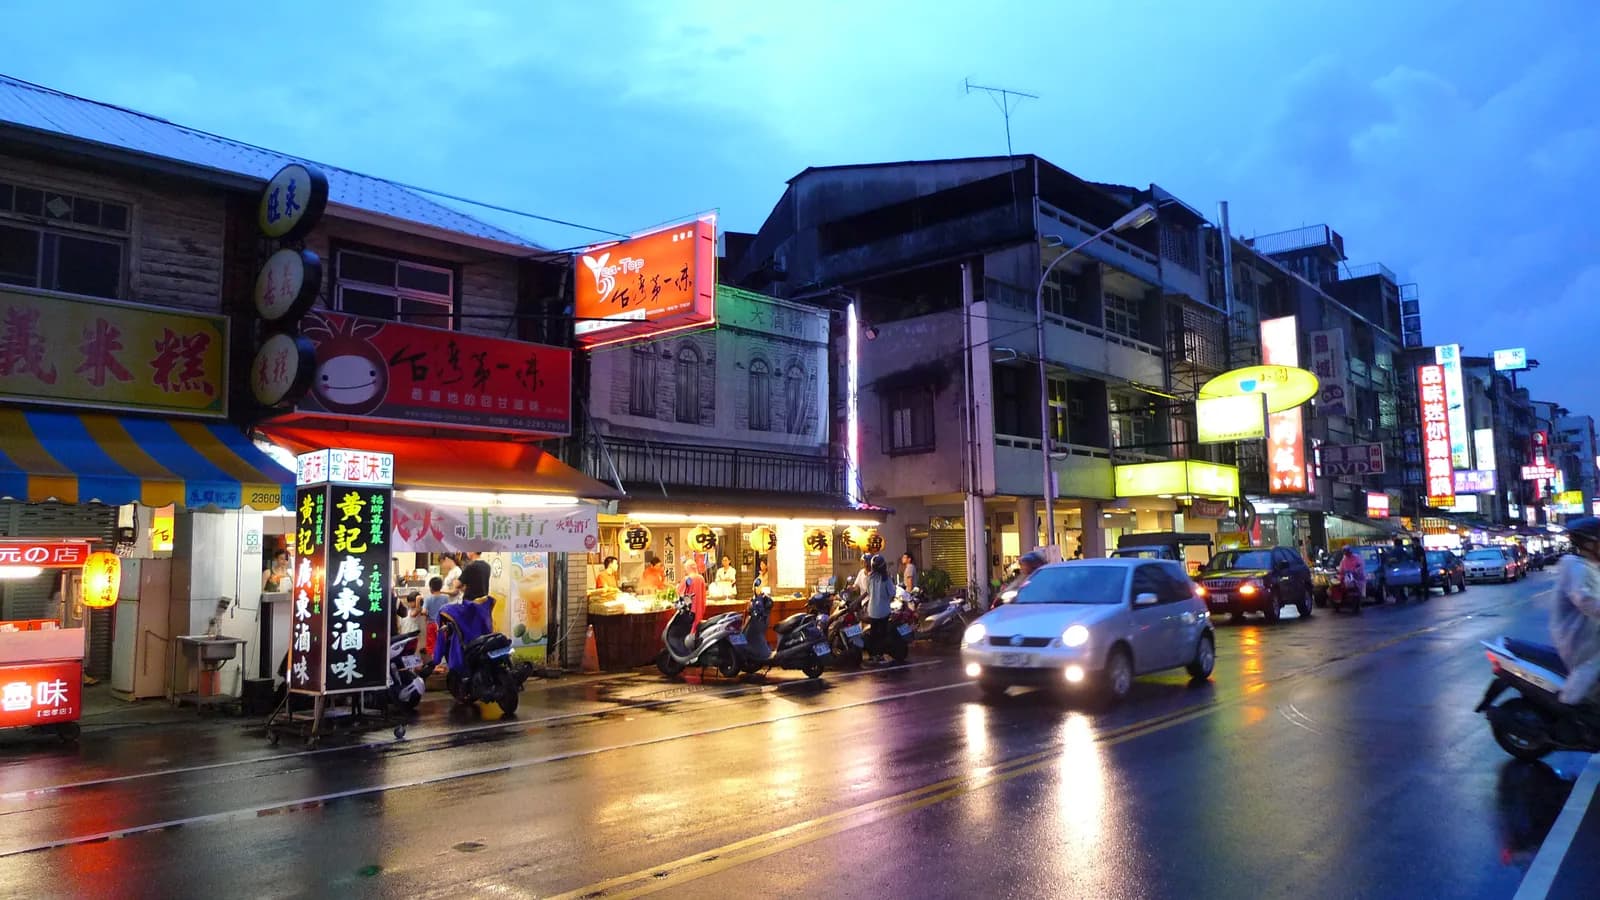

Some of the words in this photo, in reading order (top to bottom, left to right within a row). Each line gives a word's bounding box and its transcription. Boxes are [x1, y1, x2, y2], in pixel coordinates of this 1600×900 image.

[611, 264, 692, 308] 台灣第一味
[389, 340, 544, 392] 台灣第一味
[332, 453, 342, 462] 10
[381, 457, 391, 467] 10
[331, 464, 341, 476] 元
[343, 452, 380, 481] 滷味
[380, 468, 390, 478] 元
[696, 531, 717, 550] 味
[807, 534, 829, 550] 味
[0, 547, 79, 562] 元の店
